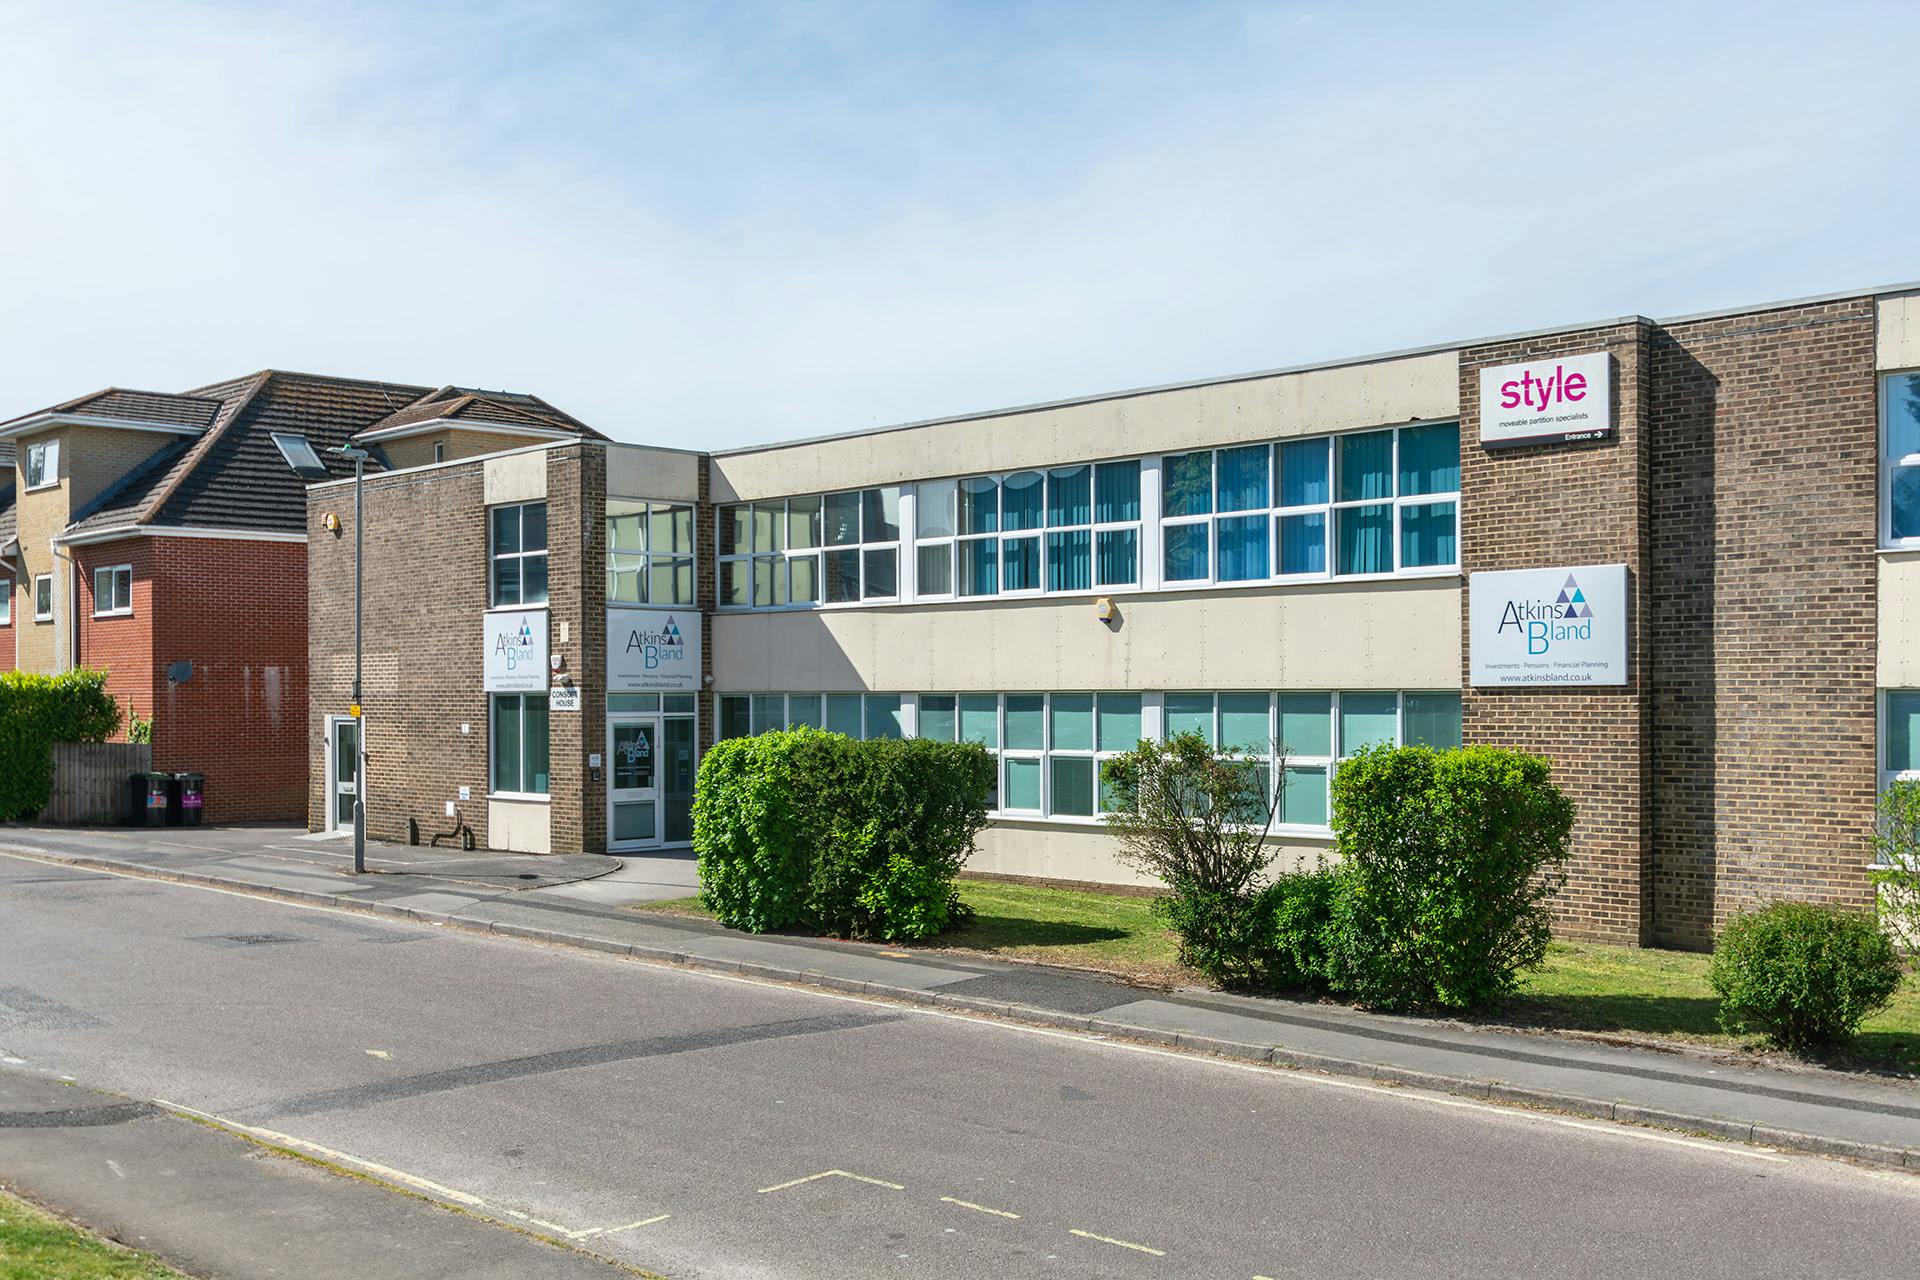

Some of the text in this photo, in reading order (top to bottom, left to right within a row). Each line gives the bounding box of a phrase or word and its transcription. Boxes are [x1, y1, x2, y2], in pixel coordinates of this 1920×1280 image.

[1500, 365, 1587, 412] style
[1499, 412, 1589, 428] moveable partition specialists
[1564, 432, 1592, 441] Entrance
[1497, 599, 1563, 634] Atkins
[494, 632, 522, 656] Atkins
[625, 630, 667, 654] Atkins
[1528, 618, 1591, 655] Bland
[507, 646, 534, 671] Bland
[645, 645, 684, 669] Bland
[1553, 661, 1580, 669] Financial
[1581, 661, 1609, 669] Planning
[1500, 673, 1592, 682] www.atkinsbland.co.uk
[556, 699, 574, 707] HOUSE
